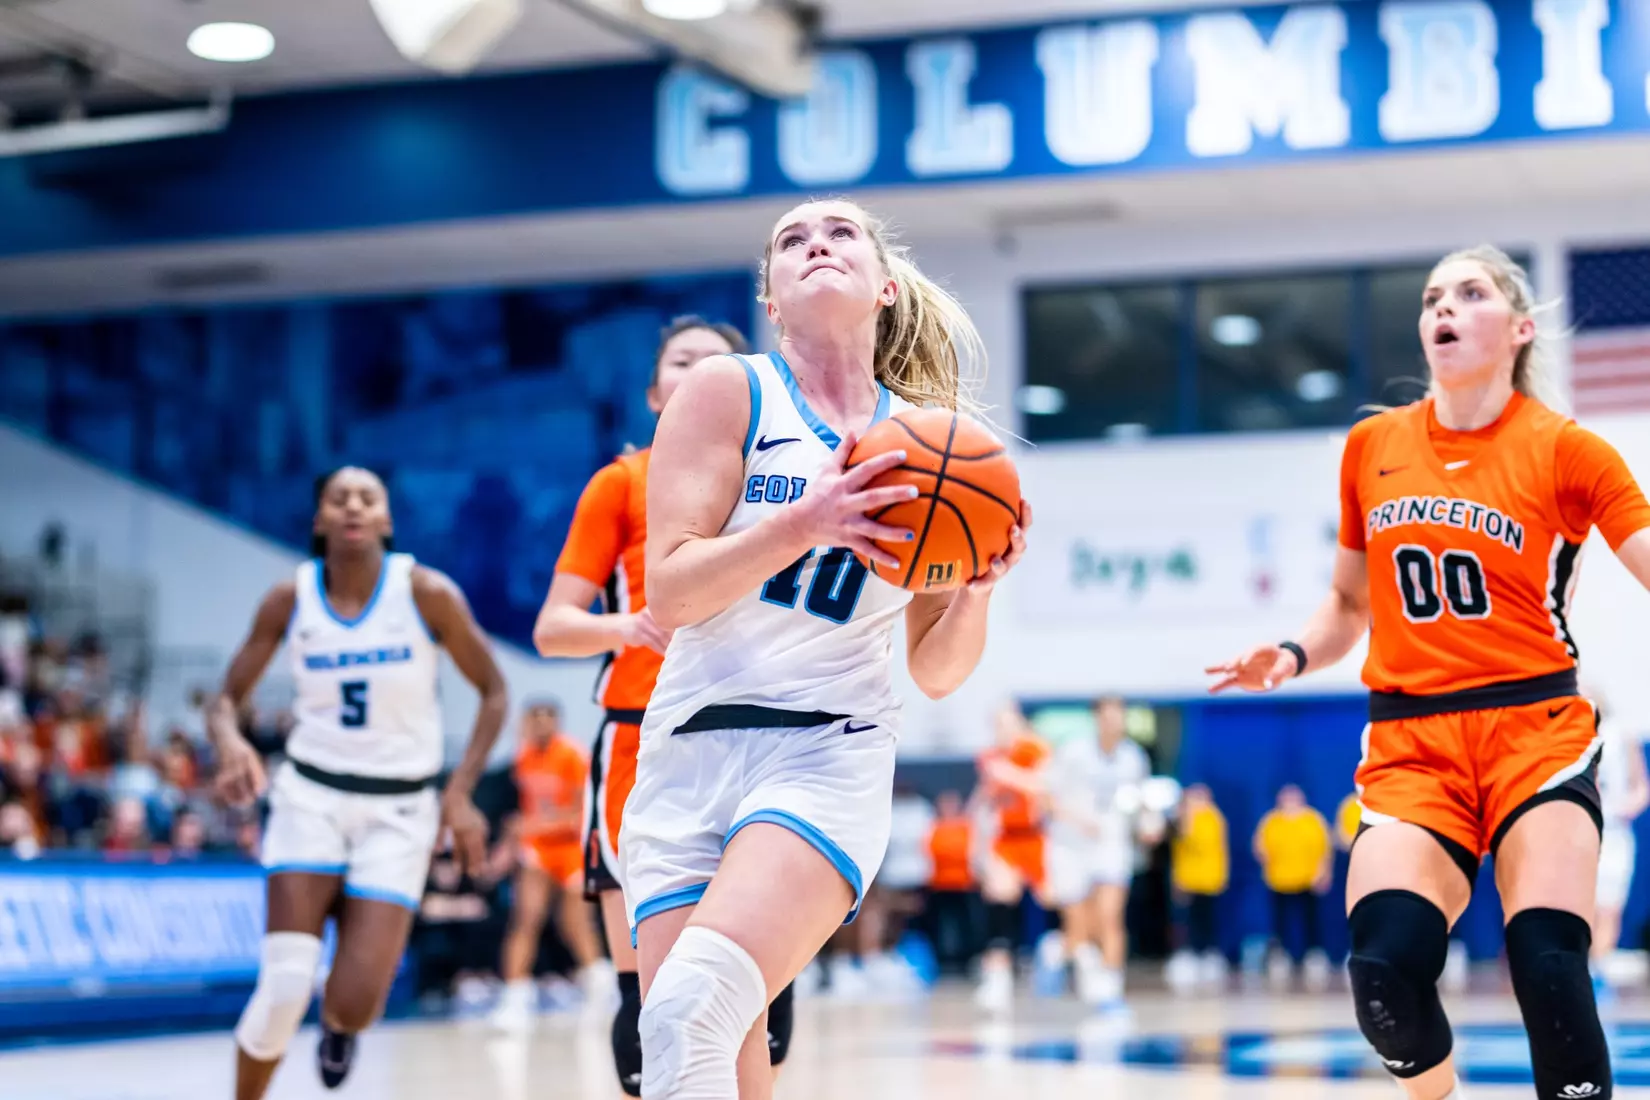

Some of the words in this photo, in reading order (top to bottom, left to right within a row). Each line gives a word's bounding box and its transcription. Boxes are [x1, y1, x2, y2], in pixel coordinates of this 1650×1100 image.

[655, 0, 1650, 195] COLUMBI
[1366, 496, 1525, 555] PRINCETON
[1392, 544, 1492, 624] 00
[339, 680, 368, 728] 5
